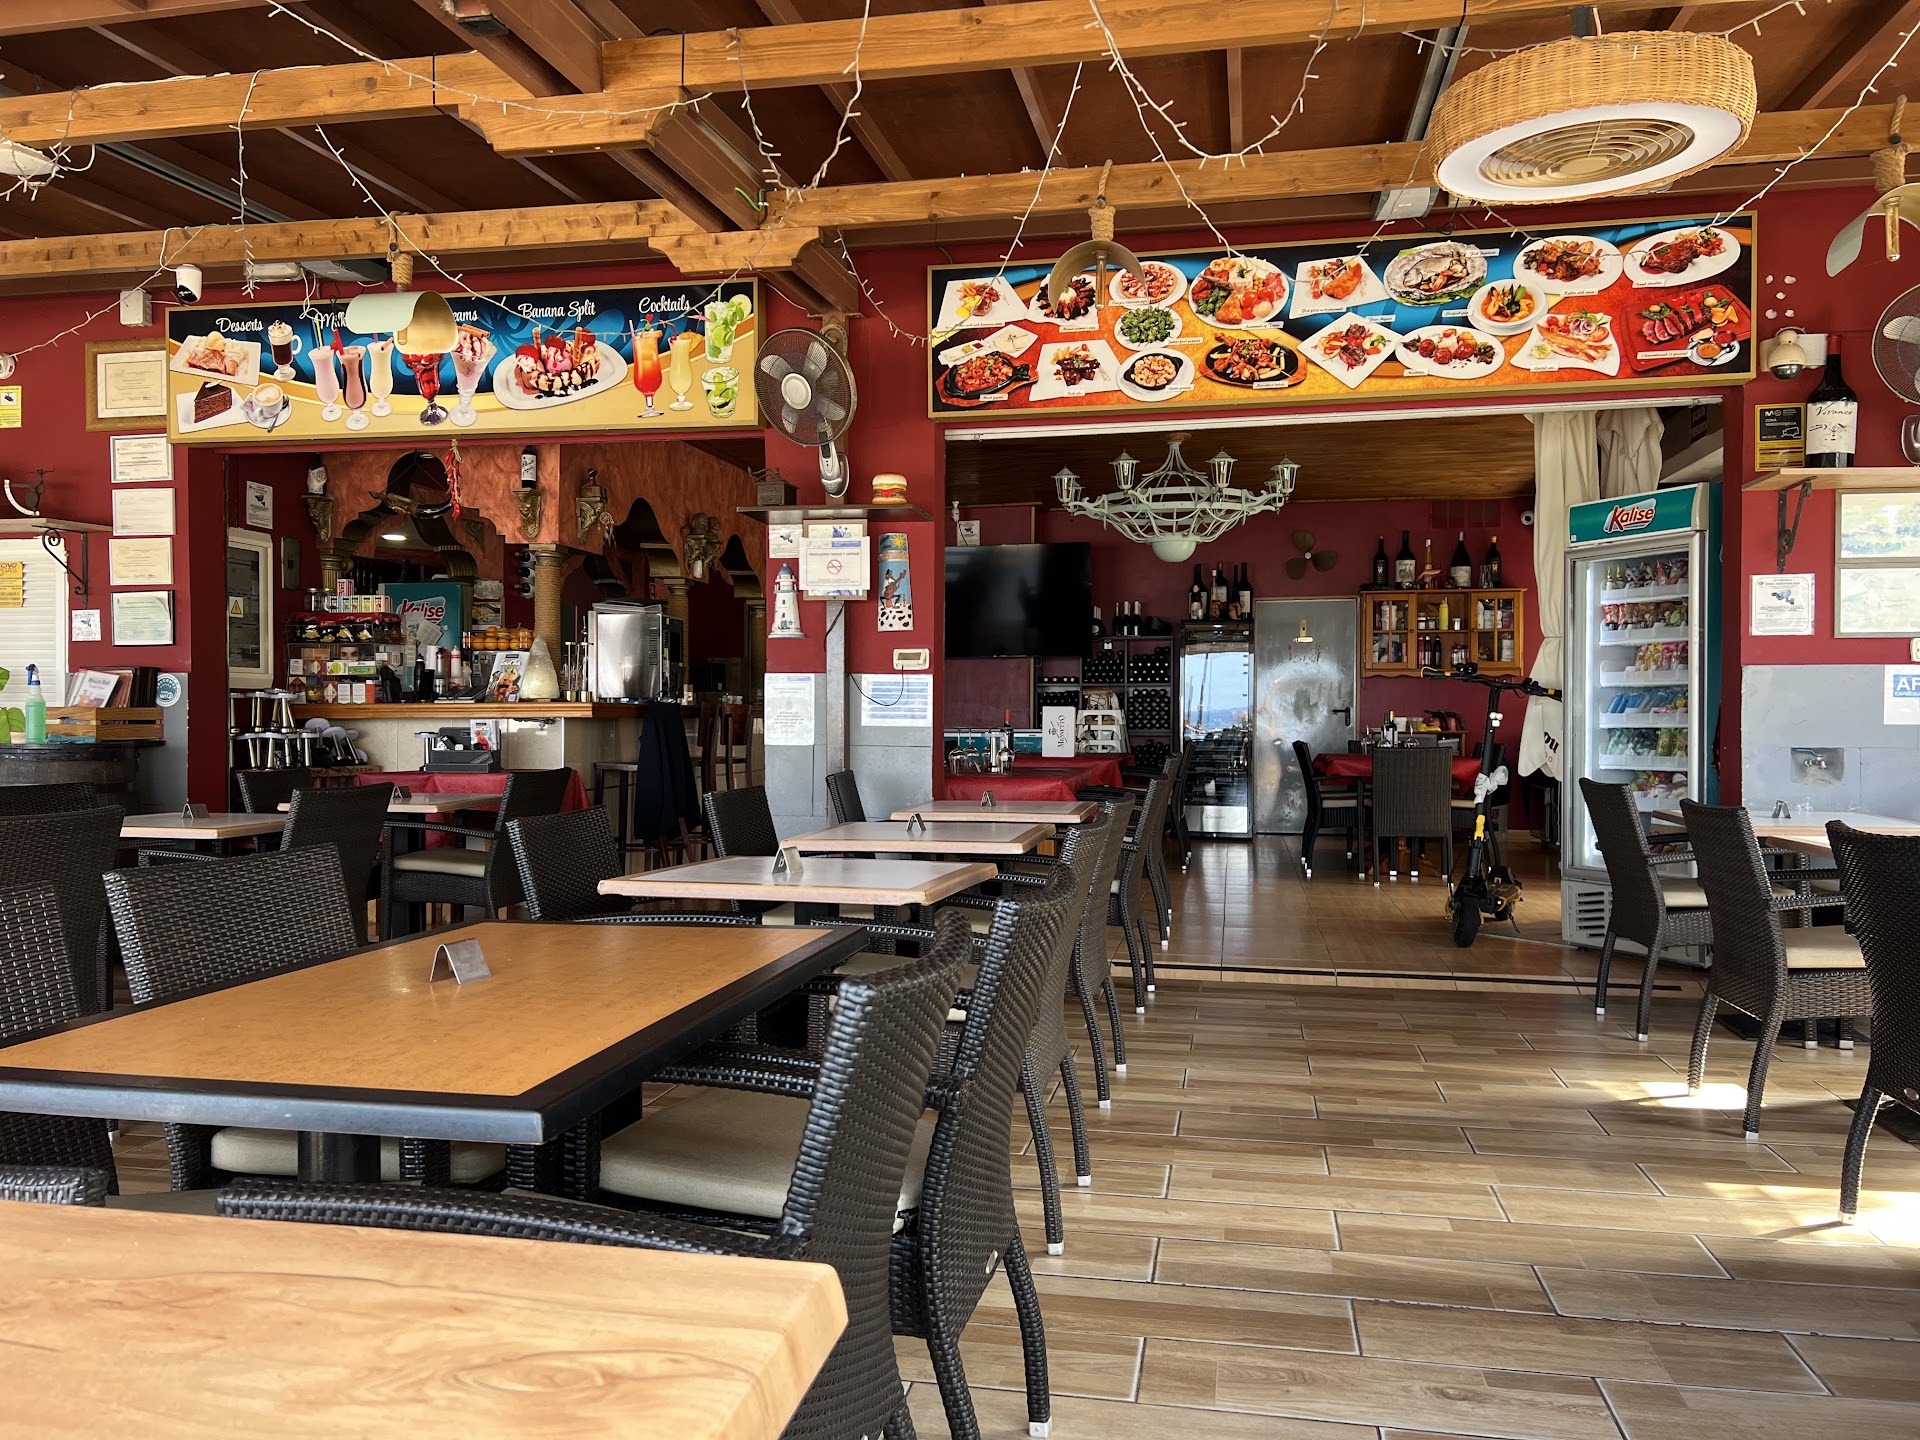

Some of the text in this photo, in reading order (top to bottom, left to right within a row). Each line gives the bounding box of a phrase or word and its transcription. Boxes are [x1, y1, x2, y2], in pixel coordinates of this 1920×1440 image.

[517, 299, 597, 322] Banana Split
[638, 294, 690, 313] Cocktails
[215, 317, 265, 333] Desserts
[1608, 506, 1655, 533] Kalise
